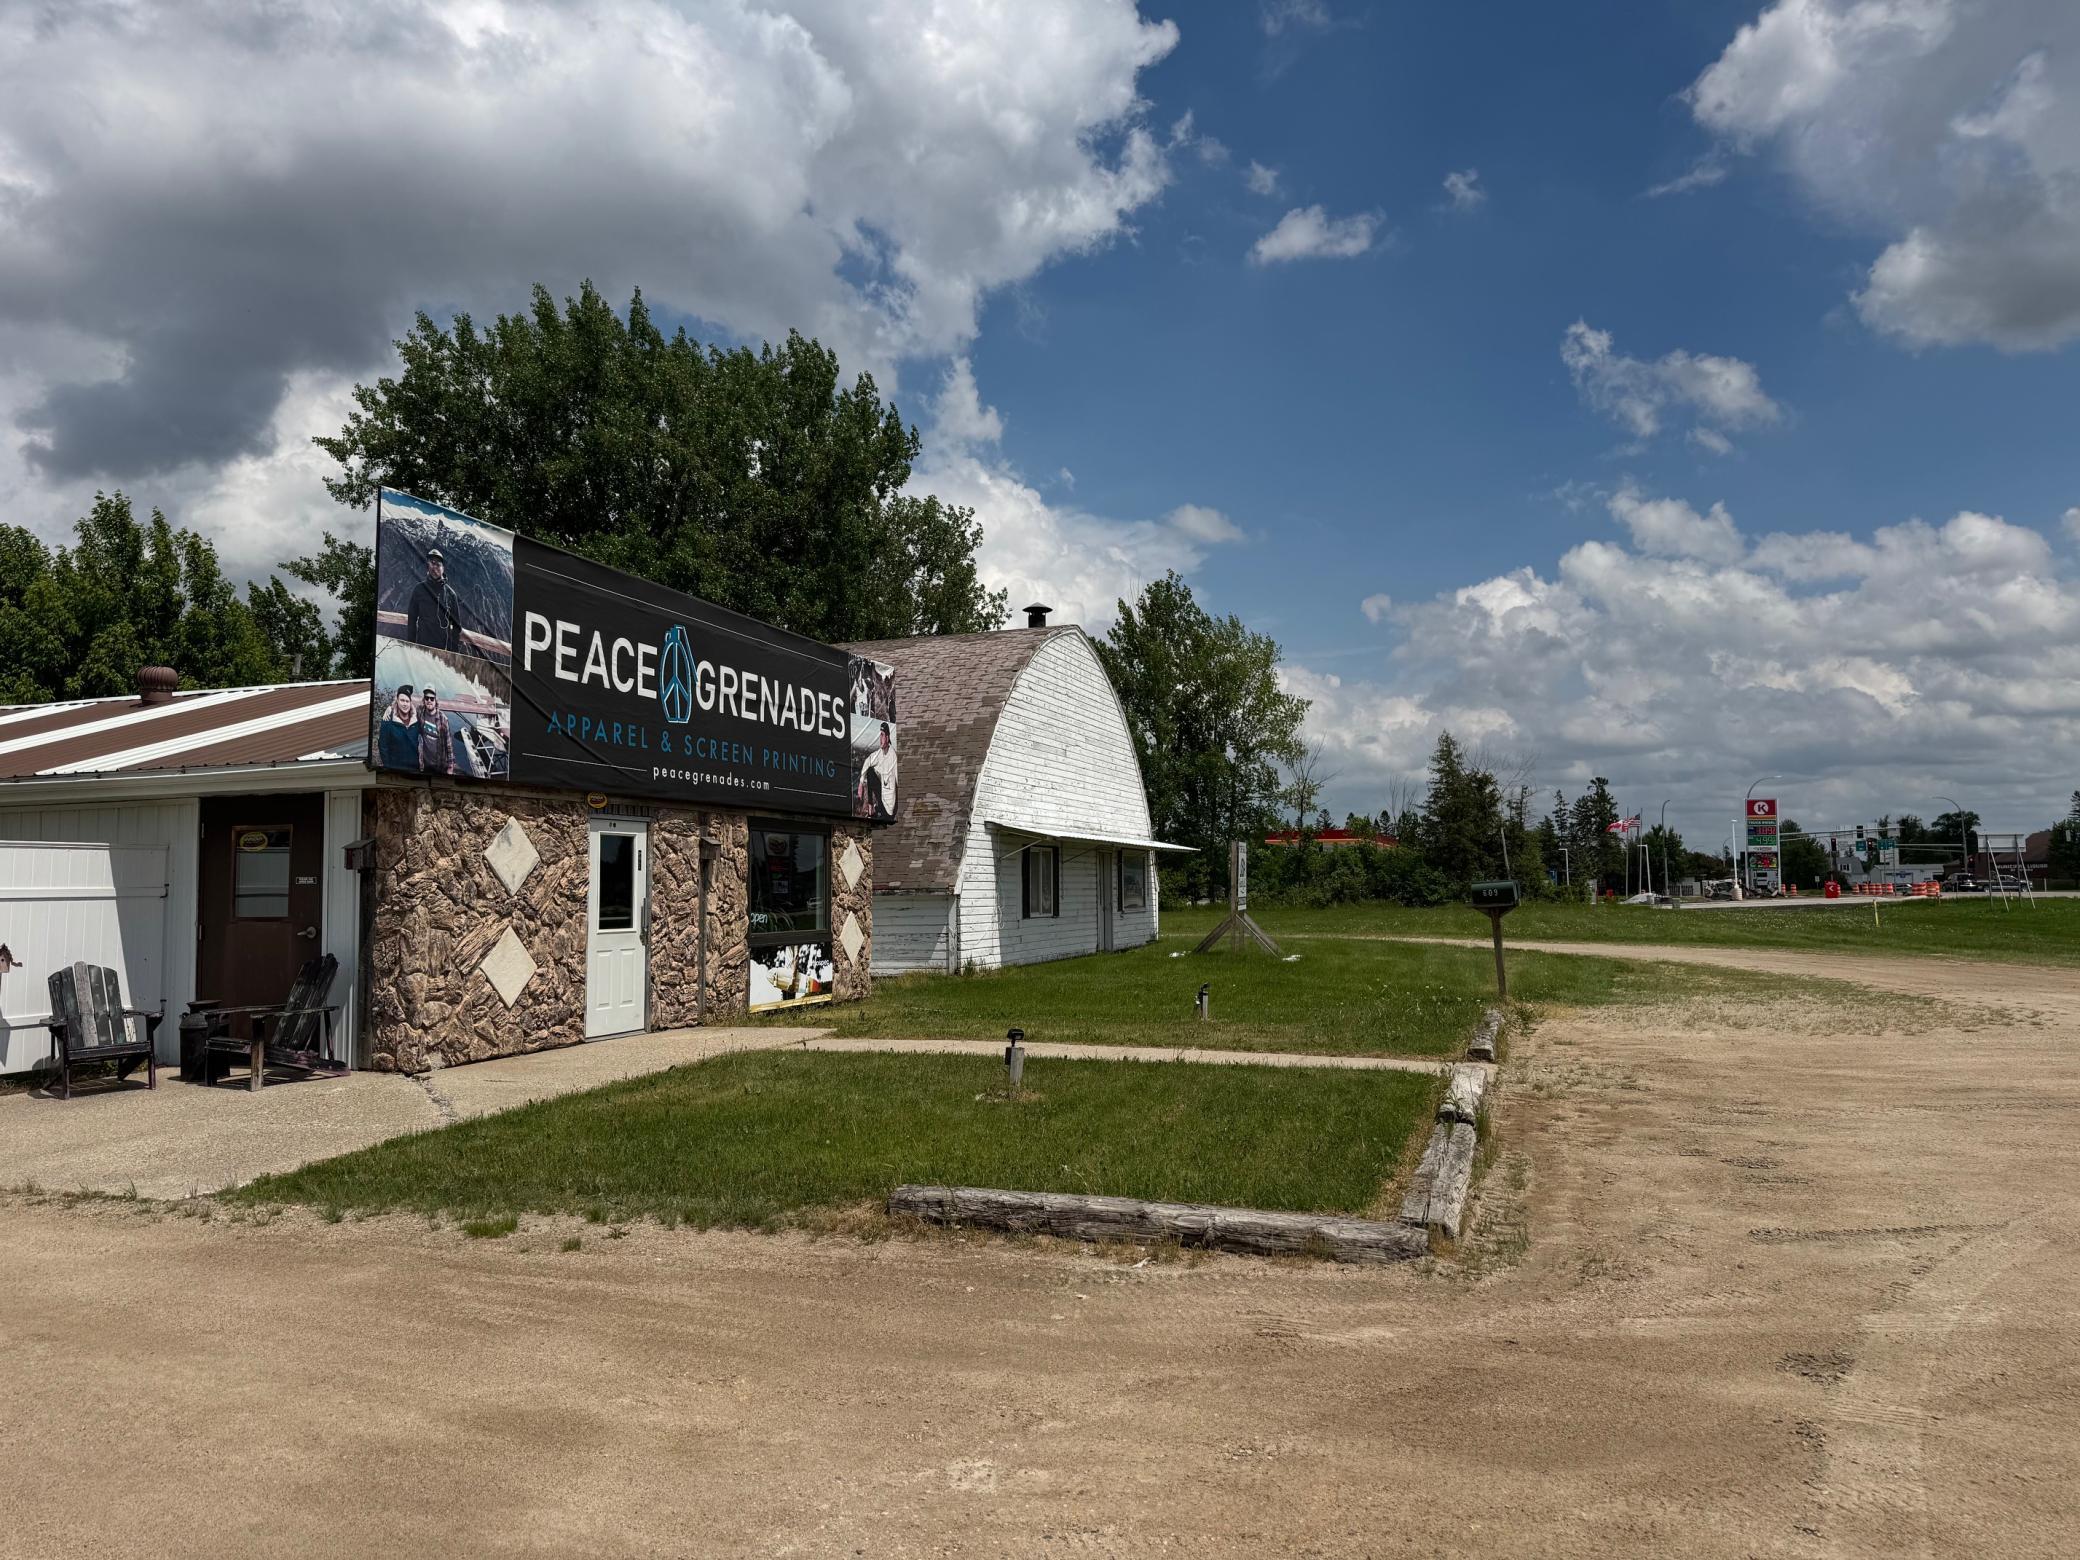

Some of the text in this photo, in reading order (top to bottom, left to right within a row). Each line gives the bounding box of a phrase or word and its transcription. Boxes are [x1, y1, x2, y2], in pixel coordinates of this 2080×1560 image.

[524, 610, 846, 740] PEACE GRENADES
[546, 710, 837, 778] APPAREL & SCREEN PRINTING
[653, 766, 770, 791] peacegrenades.com
